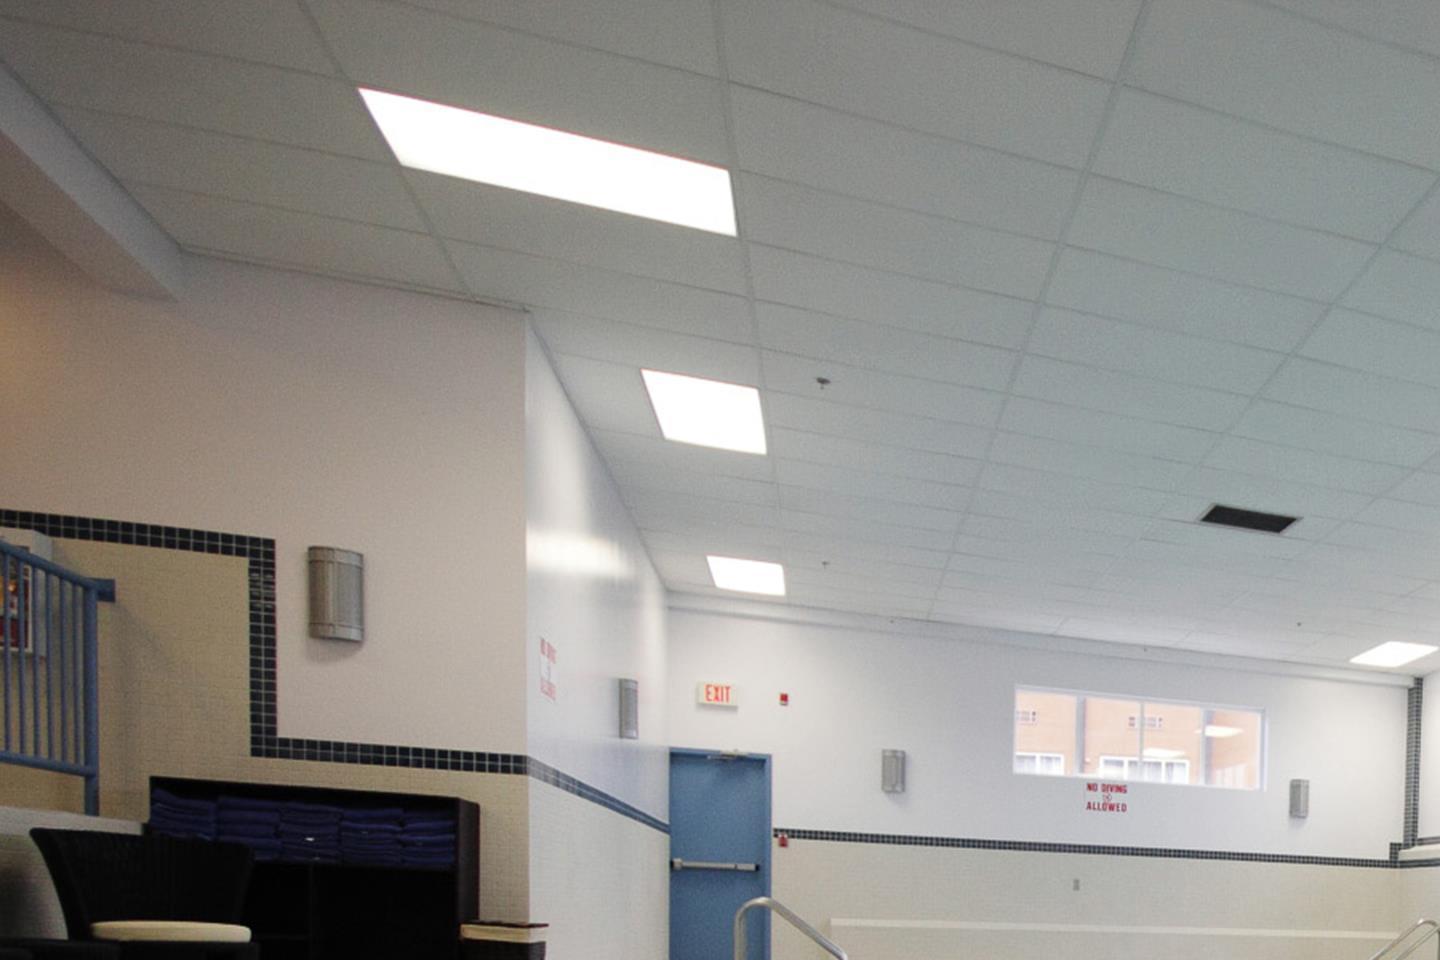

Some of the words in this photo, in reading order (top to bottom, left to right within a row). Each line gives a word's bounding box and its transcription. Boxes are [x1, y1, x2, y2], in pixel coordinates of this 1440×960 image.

[705, 684, 731, 703] EXIT
[1087, 783, 1098, 792] NO
[1101, 783, 1128, 794] DIVING
[1086, 801, 1128, 812] ALLOWED
